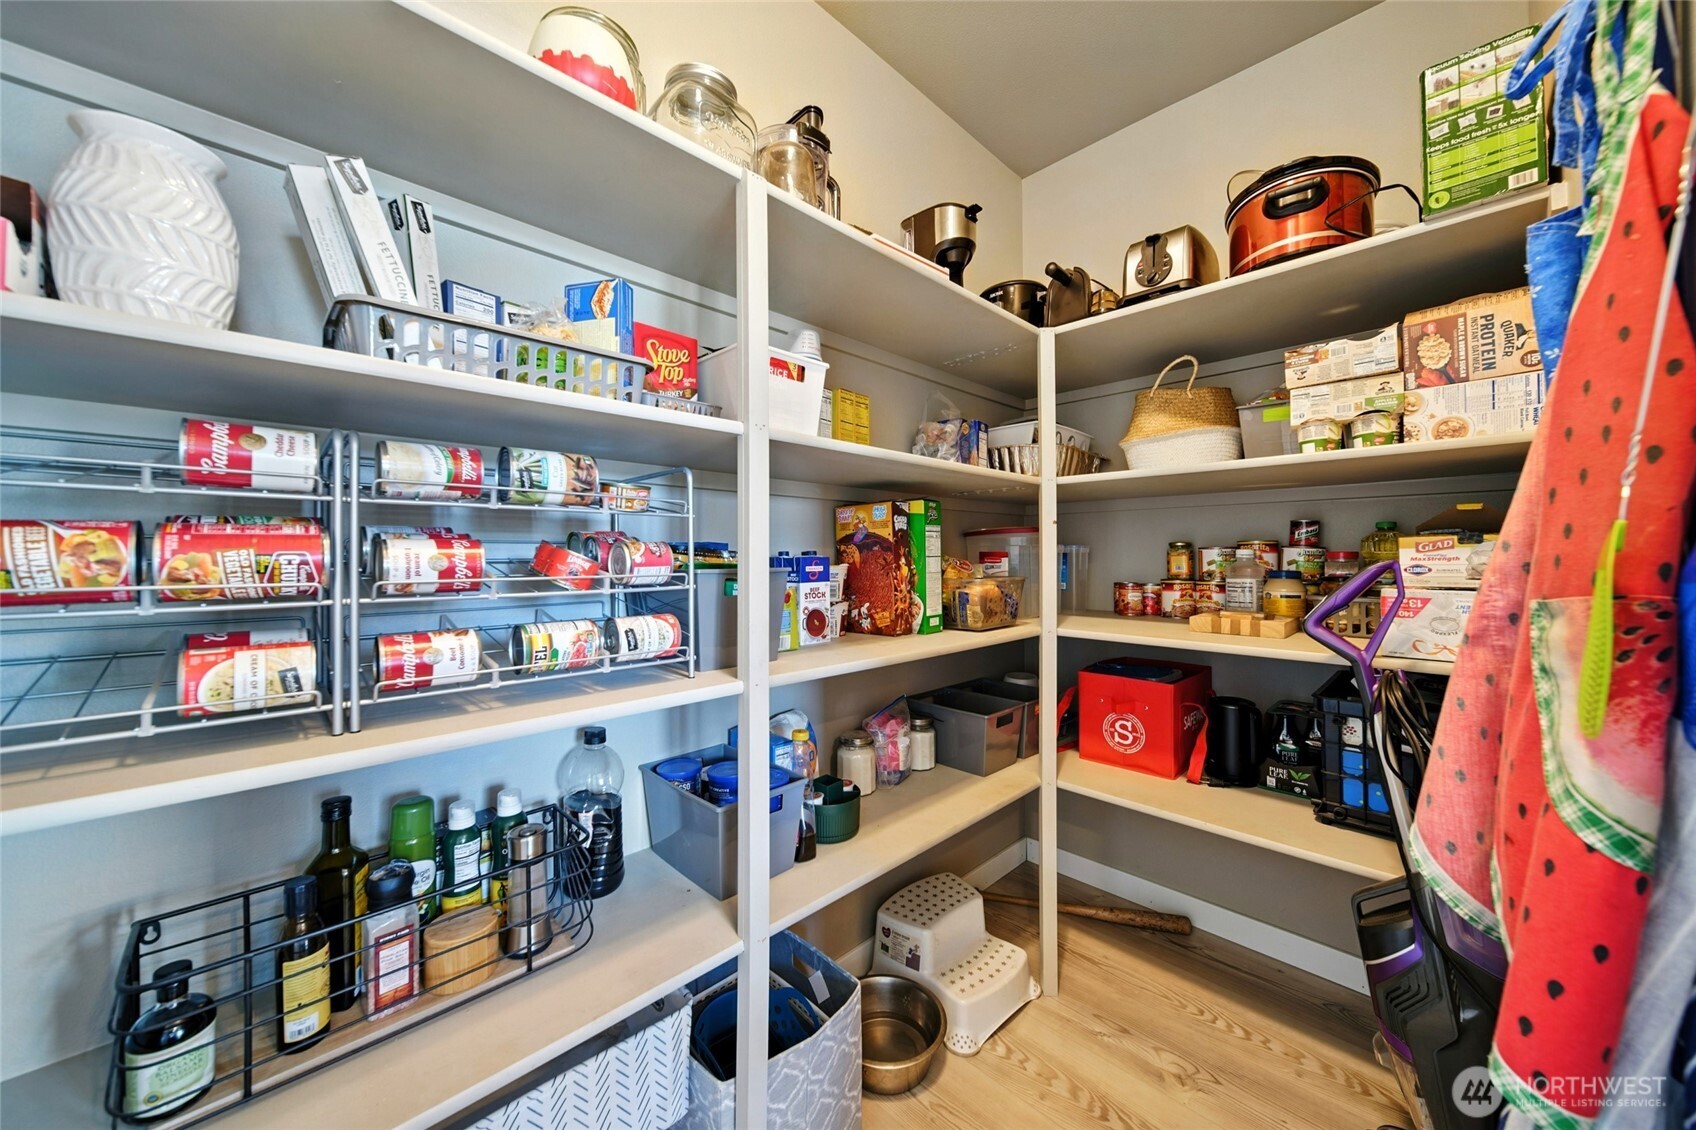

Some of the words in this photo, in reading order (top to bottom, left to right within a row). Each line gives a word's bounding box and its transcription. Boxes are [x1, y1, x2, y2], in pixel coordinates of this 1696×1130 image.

[1460, 44, 1491, 61] Sealing
[1426, 141, 1450, 153] Keeps
[1450, 134, 1470, 145] food
[1471, 127, 1492, 138] fresh
[1470, 316, 1479, 344] INSTANT
[1500, 319, 1515, 358] QUAKER
[1479, 313, 1497, 372] PROTEIN
[646, 339, 690, 370] Stove
[1471, 345, 1480, 374] OATMEAL
[657, 362, 684, 385] Top
[286, 435, 295, 456] Cheese
[1418, 539, 1453, 552] GLAD
[27, 541, 56, 596] EGETABLE
[238, 549, 251, 567] OLD
[804, 591, 827, 600] STOCK
[1408, 600, 1423, 608] 13
[250, 654, 258, 677] CREAM
[250, 681, 258, 689] OF
[1114, 720, 1133, 744] S
[1269, 766, 1289, 774] PURE
[1269, 771, 1289, 779] LEAF
